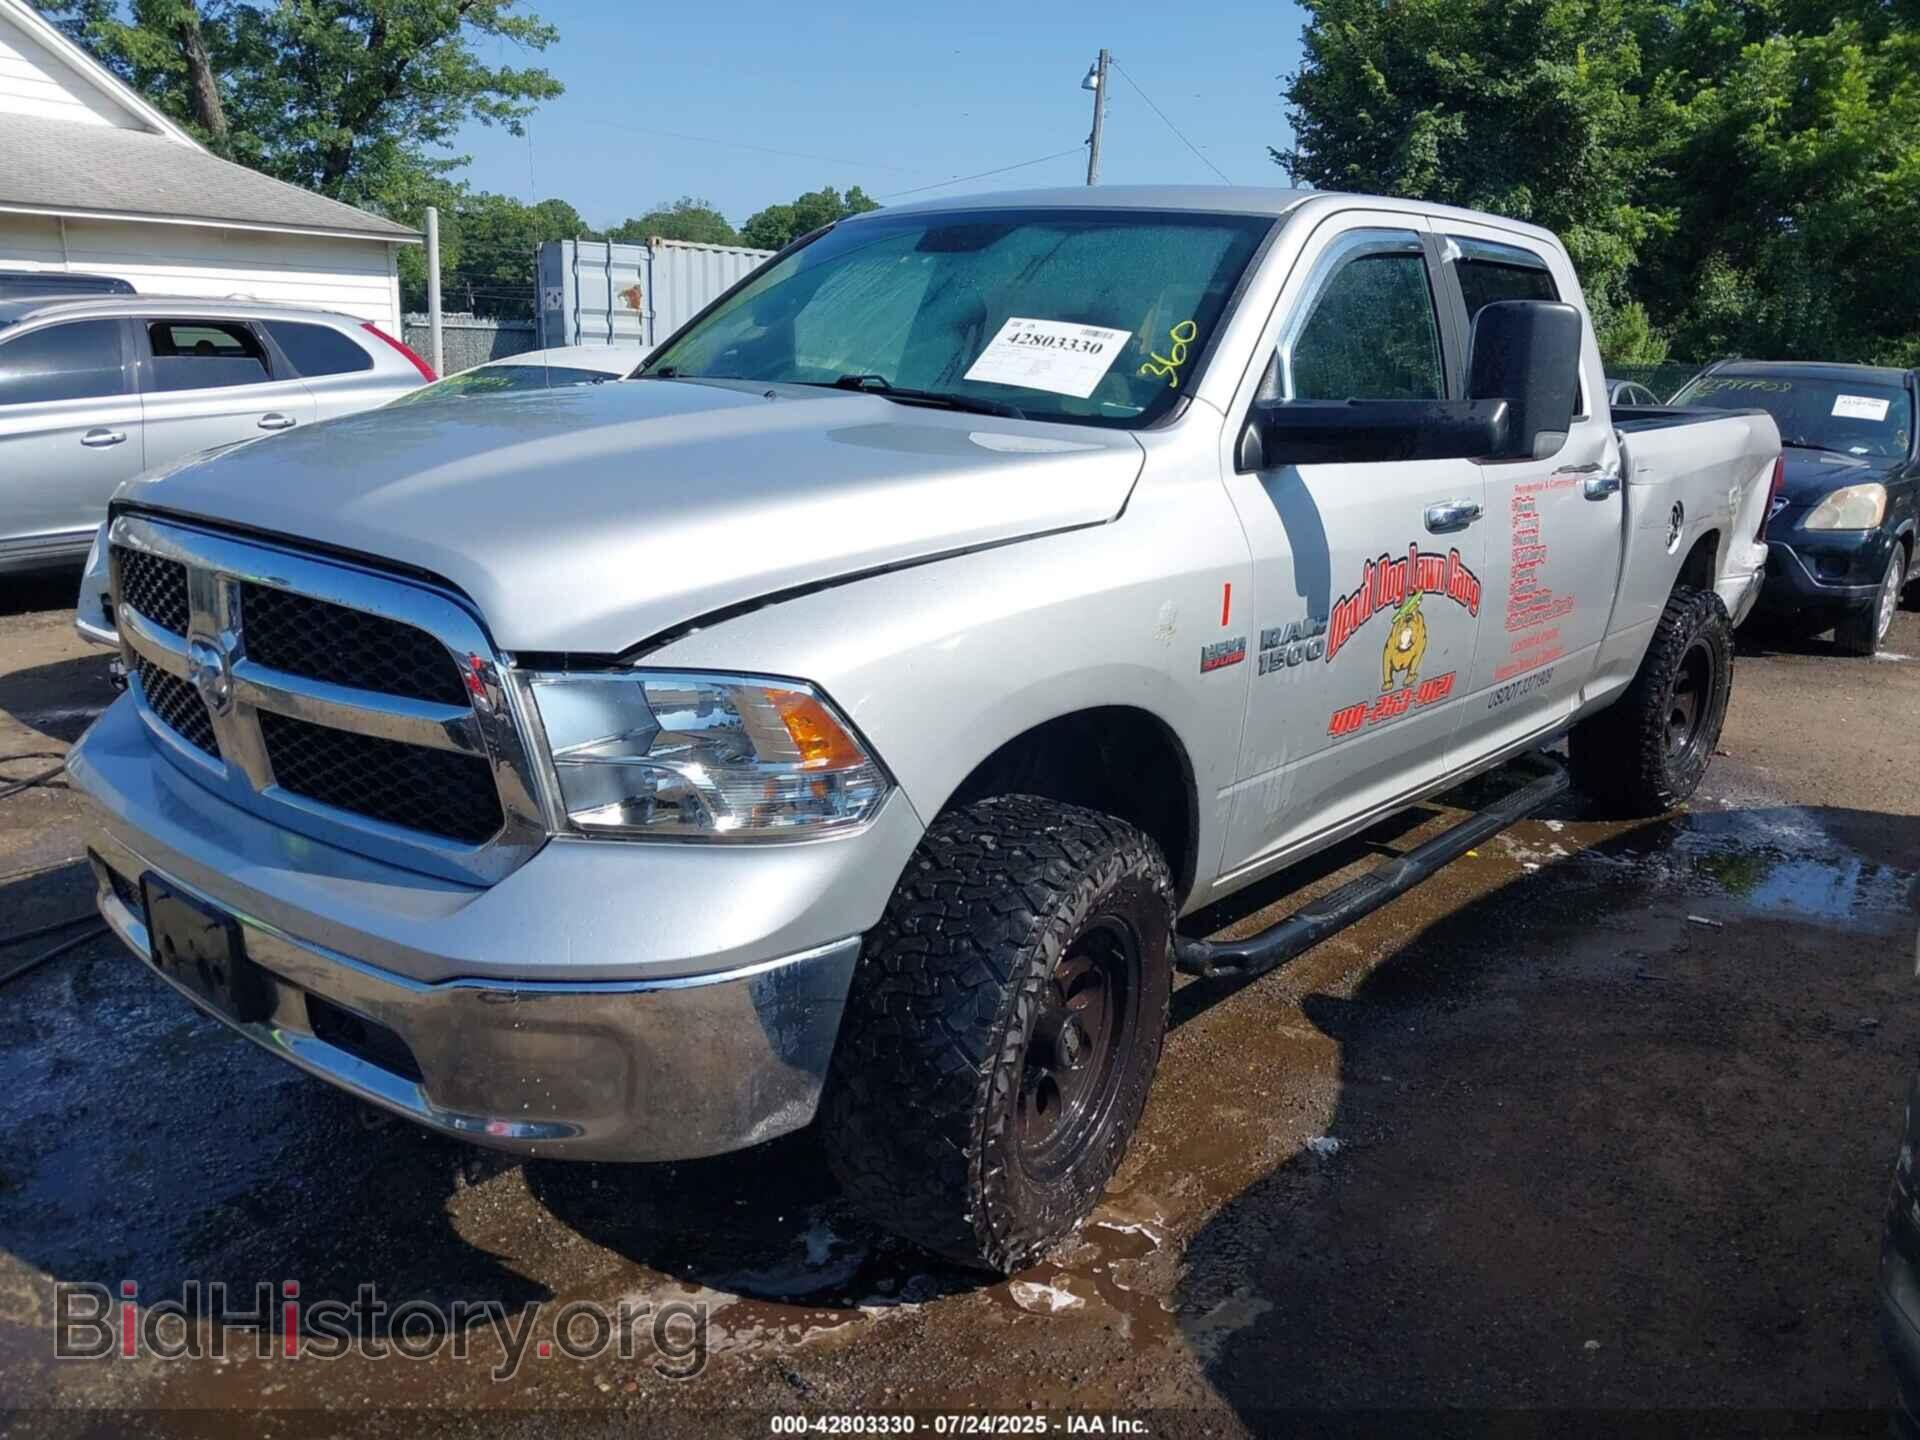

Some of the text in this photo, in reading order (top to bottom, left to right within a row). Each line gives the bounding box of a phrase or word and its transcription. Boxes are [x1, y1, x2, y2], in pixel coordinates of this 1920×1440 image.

[1007, 331, 1104, 356] 42803330
[1137, 320, 1198, 388] 360
[1408, 541, 1447, 597] Lawn
[1258, 638, 1326, 677] 1500
